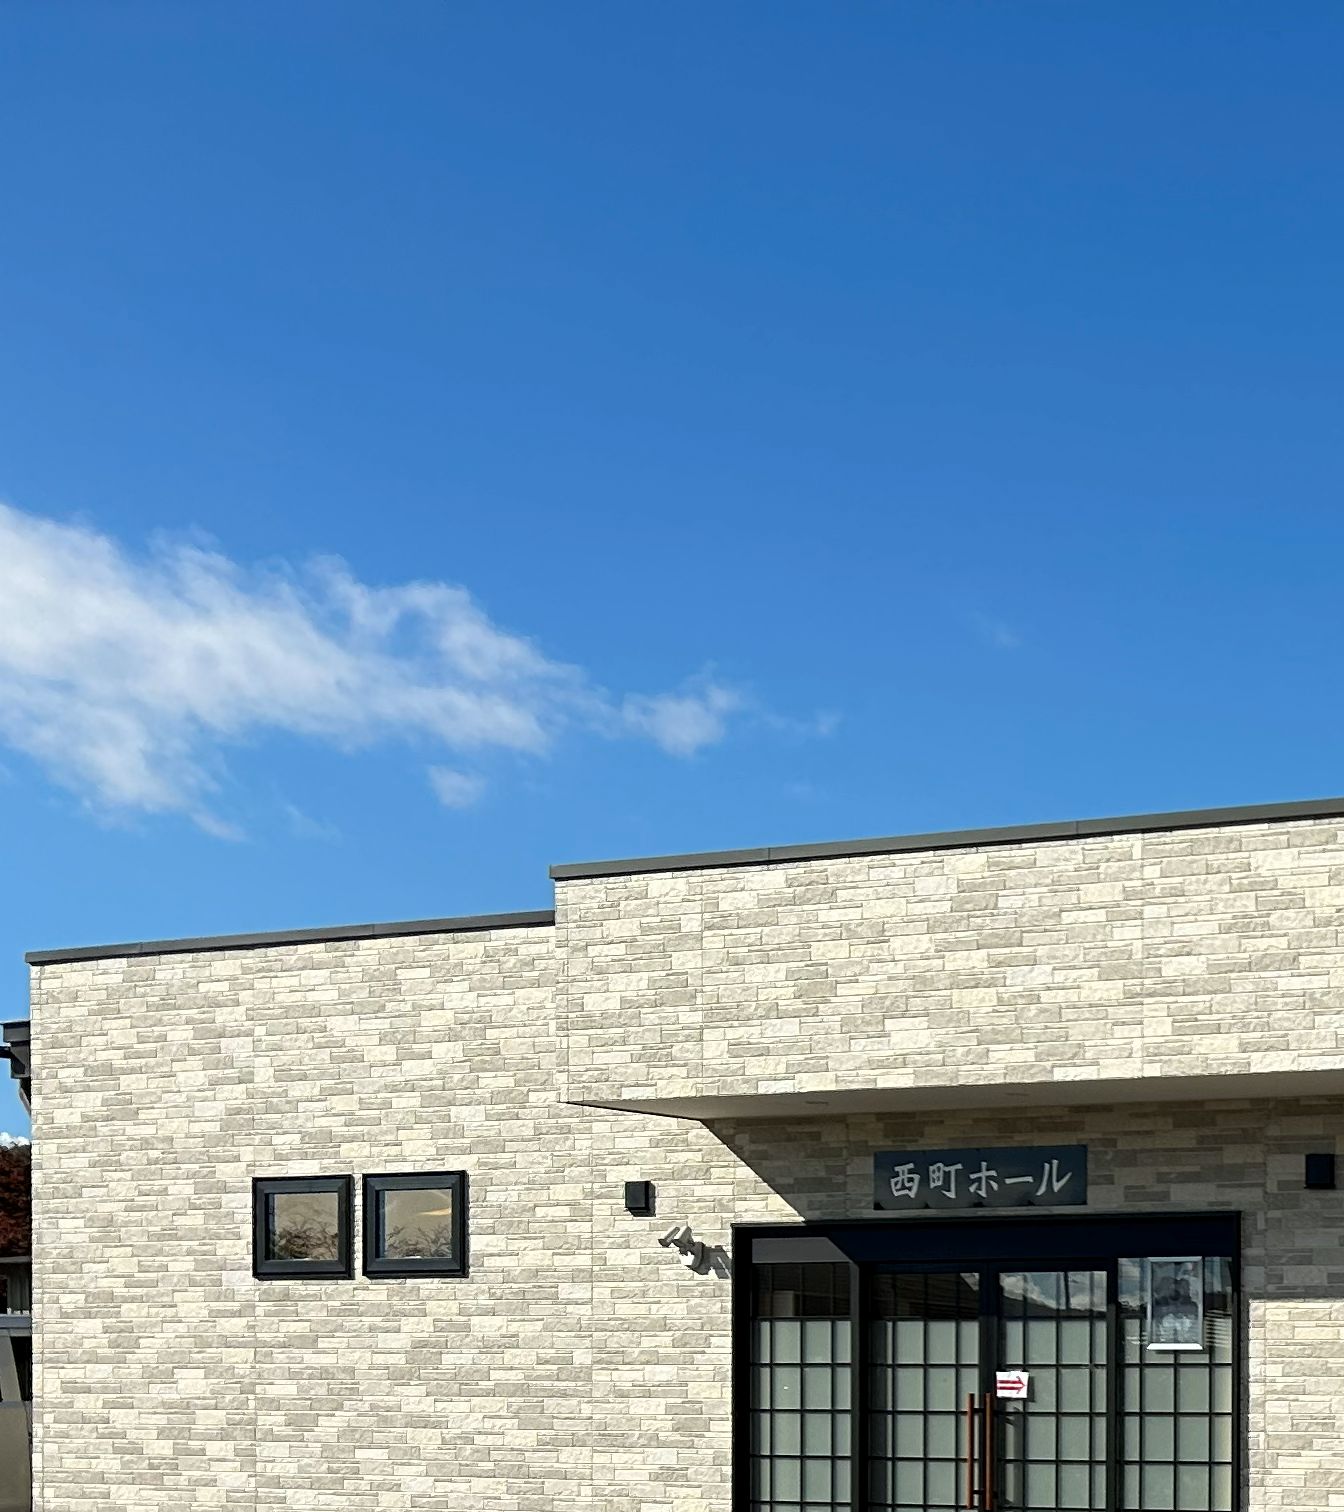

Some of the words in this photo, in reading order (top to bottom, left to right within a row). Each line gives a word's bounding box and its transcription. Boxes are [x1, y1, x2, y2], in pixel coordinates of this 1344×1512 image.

[890, 1159, 1072, 1199] 西町ホール
